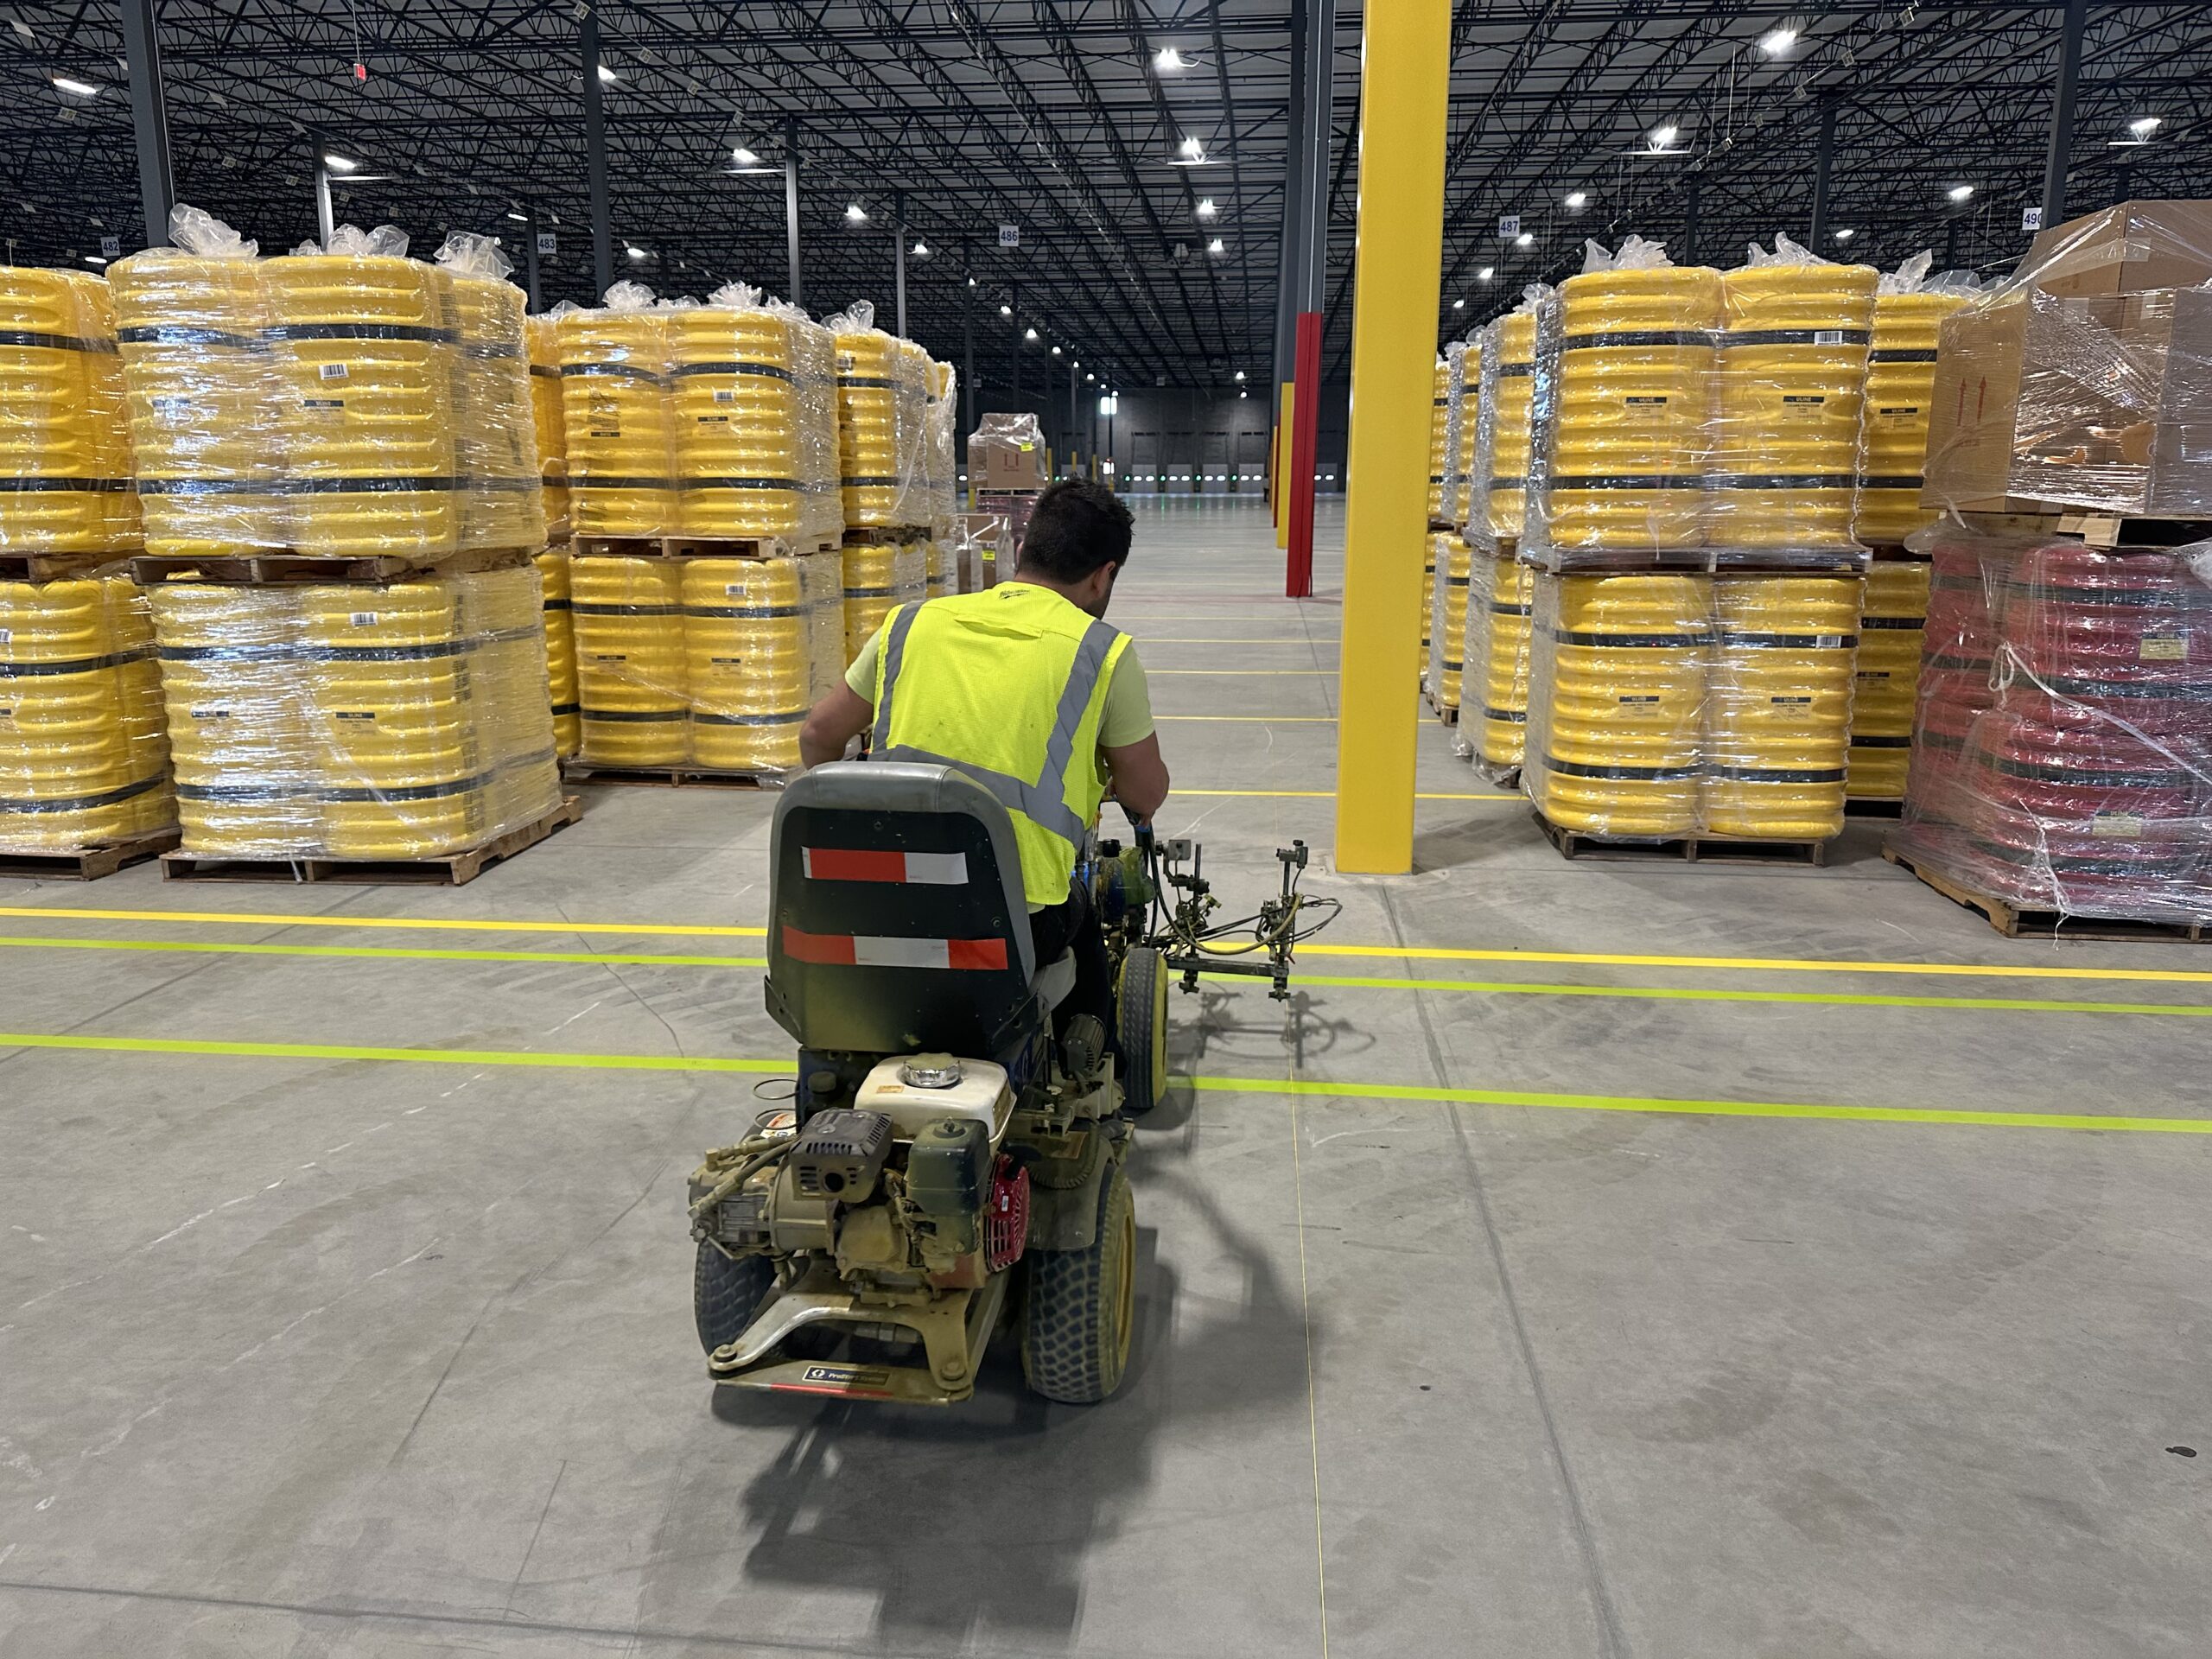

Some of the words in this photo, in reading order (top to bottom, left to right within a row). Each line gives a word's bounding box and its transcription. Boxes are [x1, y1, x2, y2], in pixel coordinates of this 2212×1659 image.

[1500, 220, 1518, 232] 487
[1001, 230, 1018, 242] 486
[103, 240, 119, 251] 482
[538, 238, 556, 249] 483
